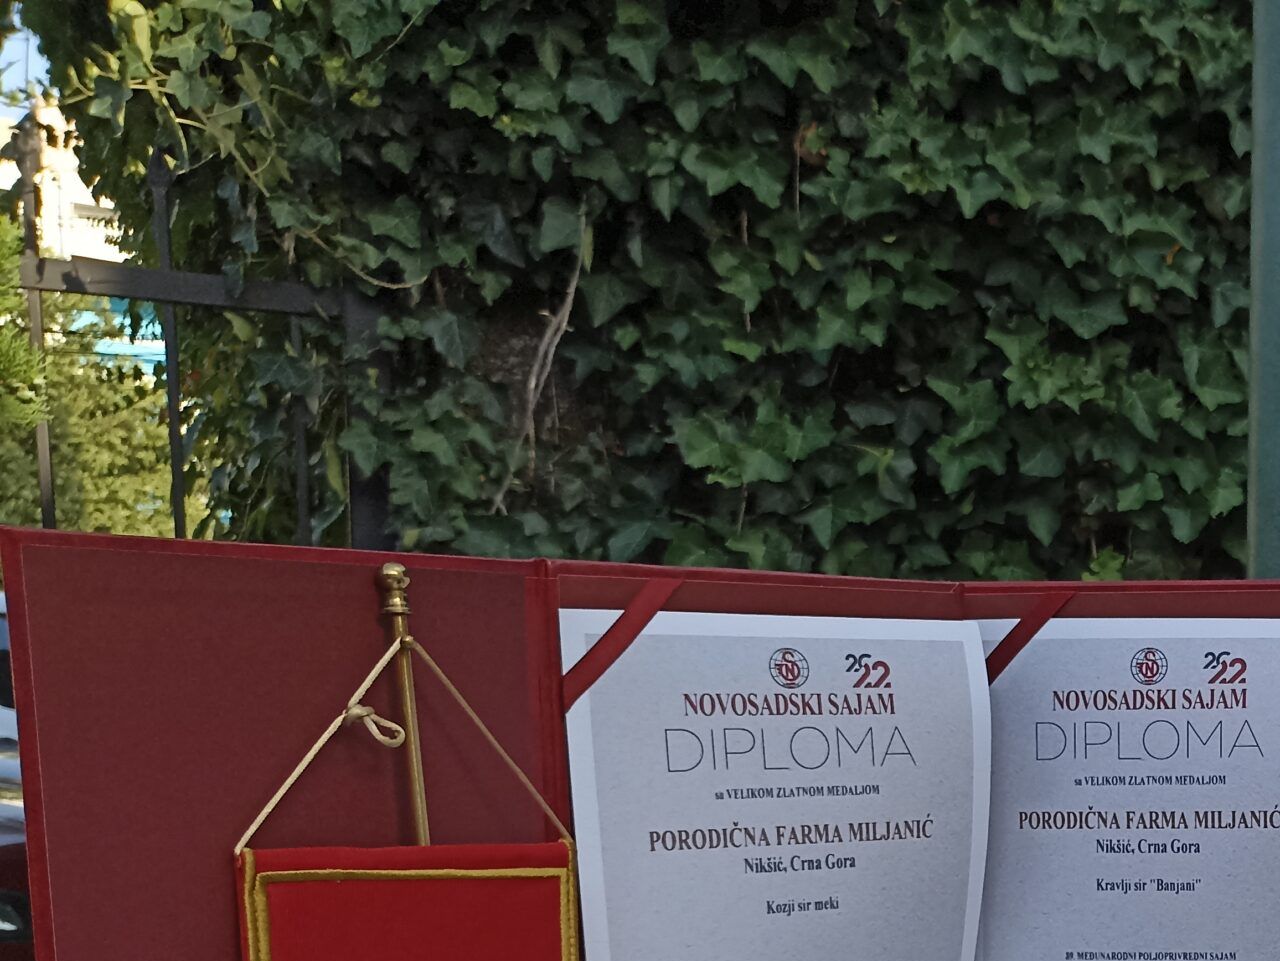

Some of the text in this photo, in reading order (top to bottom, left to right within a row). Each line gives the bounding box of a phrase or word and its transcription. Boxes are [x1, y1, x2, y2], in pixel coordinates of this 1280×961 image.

[683, 693, 895, 716] NOVOSADSKI SAJAM
[1053, 689, 1247, 711] NOVOSADSKI SAJAM
[665, 726, 916, 772] DIPLOMA
[1036, 720, 1264, 760] DIPLOMA
[1085, 776, 1125, 786] VELIKOM
[1128, 776, 1172, 785] ZLATNOM
[1175, 775, 1225, 785] MEDALJOM
[726, 788, 773, 799] VELIKOM
[777, 786, 824, 798] ZLATNOM
[827, 785, 879, 796] MEDALJOM
[1019, 805, 1280, 829] PORODIČNA FARMA MILJANIĆ
[649, 813, 933, 851] PORODIČNA FARMA MILJANIĆ
[1097, 839, 1200, 854] Nikšić, Crna Gora
[744, 854, 855, 873] Nikšić, Crna Gora
[1097, 879, 1201, 894] Kravlji sir "Banjani"
[767, 897, 839, 916] Kozji sir meki
[1209, 952, 1237, 961] SAJAM
